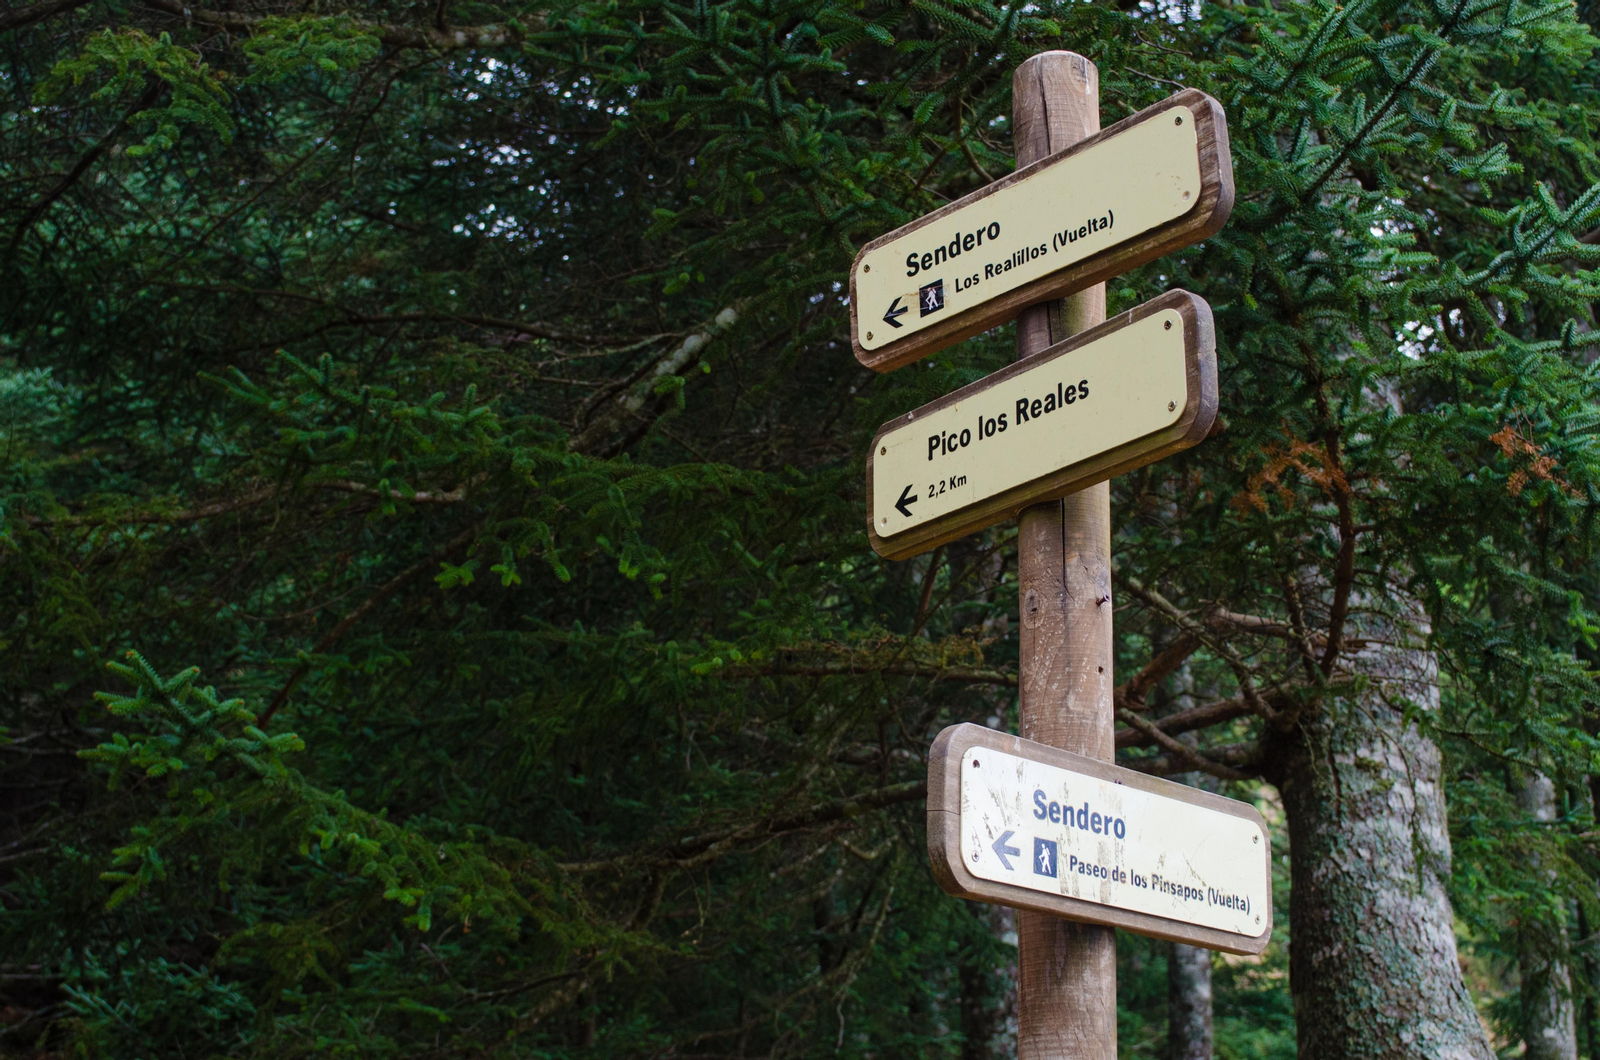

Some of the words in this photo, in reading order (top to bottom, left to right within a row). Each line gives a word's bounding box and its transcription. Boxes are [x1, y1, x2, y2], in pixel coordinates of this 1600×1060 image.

[906, 221, 1000, 277] Sendero
[955, 273, 980, 293] Los
[984, 243, 1047, 280] Realillos
[1052, 209, 1114, 252] (Vuelta)
[928, 428, 971, 461] Pico
[978, 413, 1008, 440] los
[1016, 379, 1090, 425] Reales
[928, 480, 946, 499] 2,2
[949, 474, 967, 490] Km
[1033, 789, 1126, 839] Sendero
[1069, 854, 1107, 879] Paseo
[1112, 865, 1127, 884] de
[1130, 869, 1148, 889] los
[1151, 874, 1204, 902] Pinsapos
[1207, 886, 1251, 916] (Vuelta)
